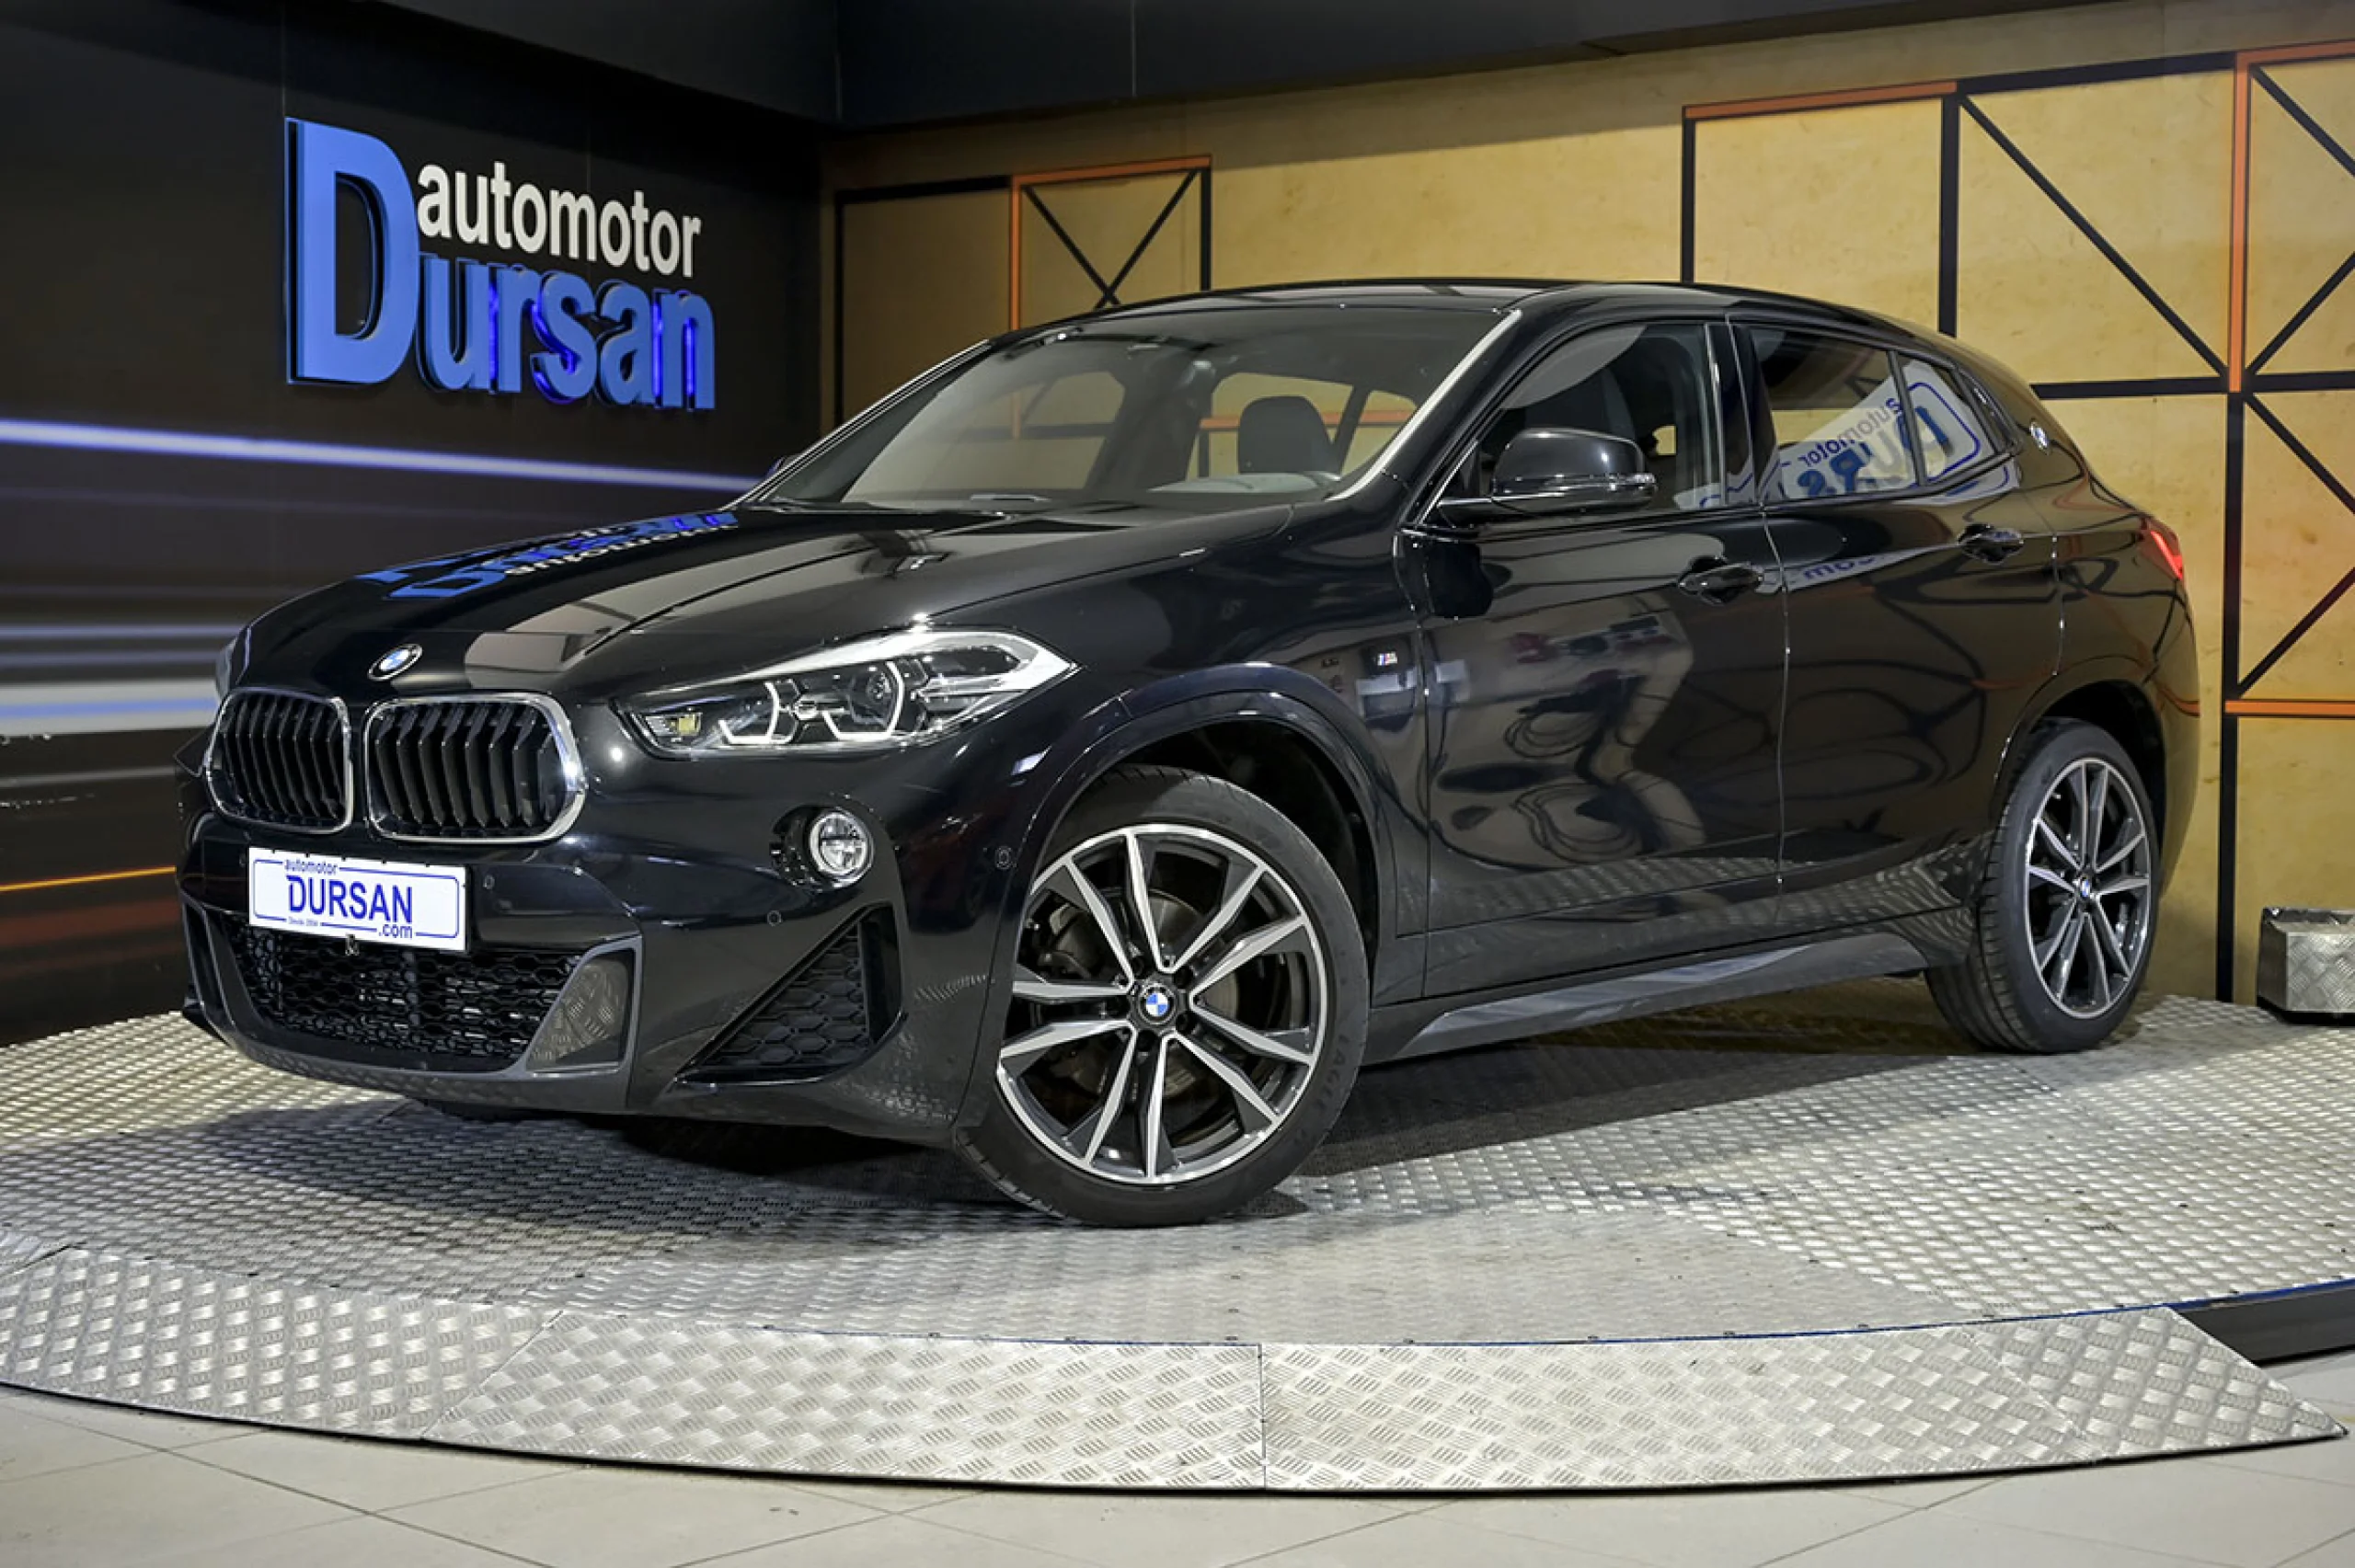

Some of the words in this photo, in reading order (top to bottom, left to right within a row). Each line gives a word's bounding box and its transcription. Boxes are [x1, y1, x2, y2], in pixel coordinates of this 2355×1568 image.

[417, 161, 703, 278] automotor
[284, 116, 716, 410] Dursan
[285, 859, 338, 875] automotor
[286, 875, 413, 923] DURSAN
[378, 923, 413, 939] .com
